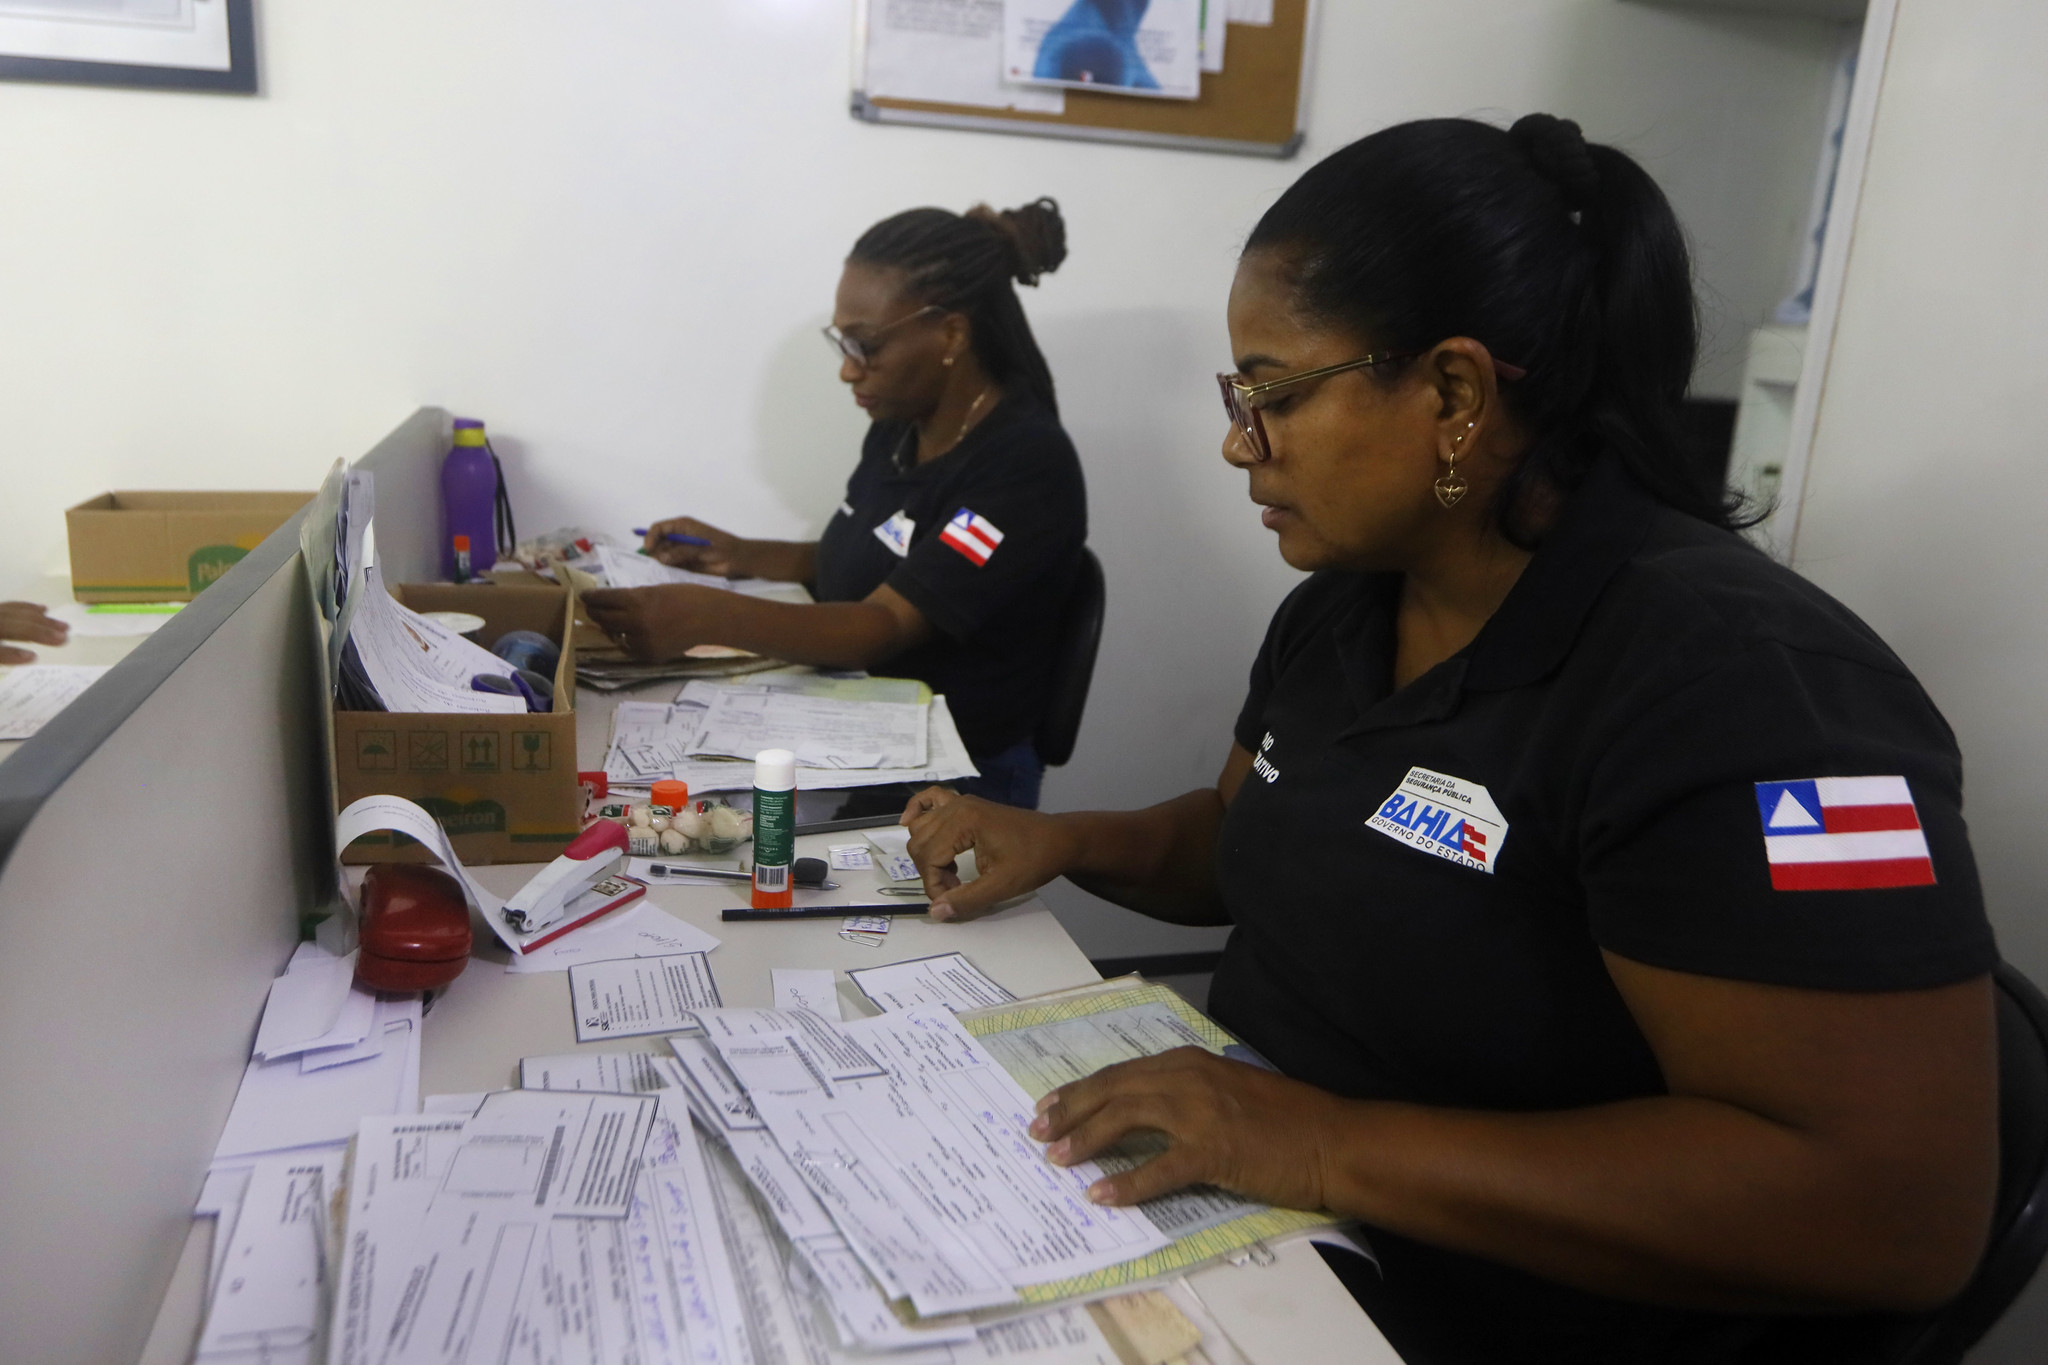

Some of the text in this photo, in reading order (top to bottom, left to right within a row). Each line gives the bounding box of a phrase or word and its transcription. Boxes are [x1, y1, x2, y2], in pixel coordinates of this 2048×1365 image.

[1405, 778, 1472, 804] SEGURANÇA PÚBLICA
[1410, 770, 1456, 789] SECRETARIA DA
[1378, 793, 1466, 853] BAHIA
[1371, 816, 1486, 872] GOVERNO DO ESTADO
